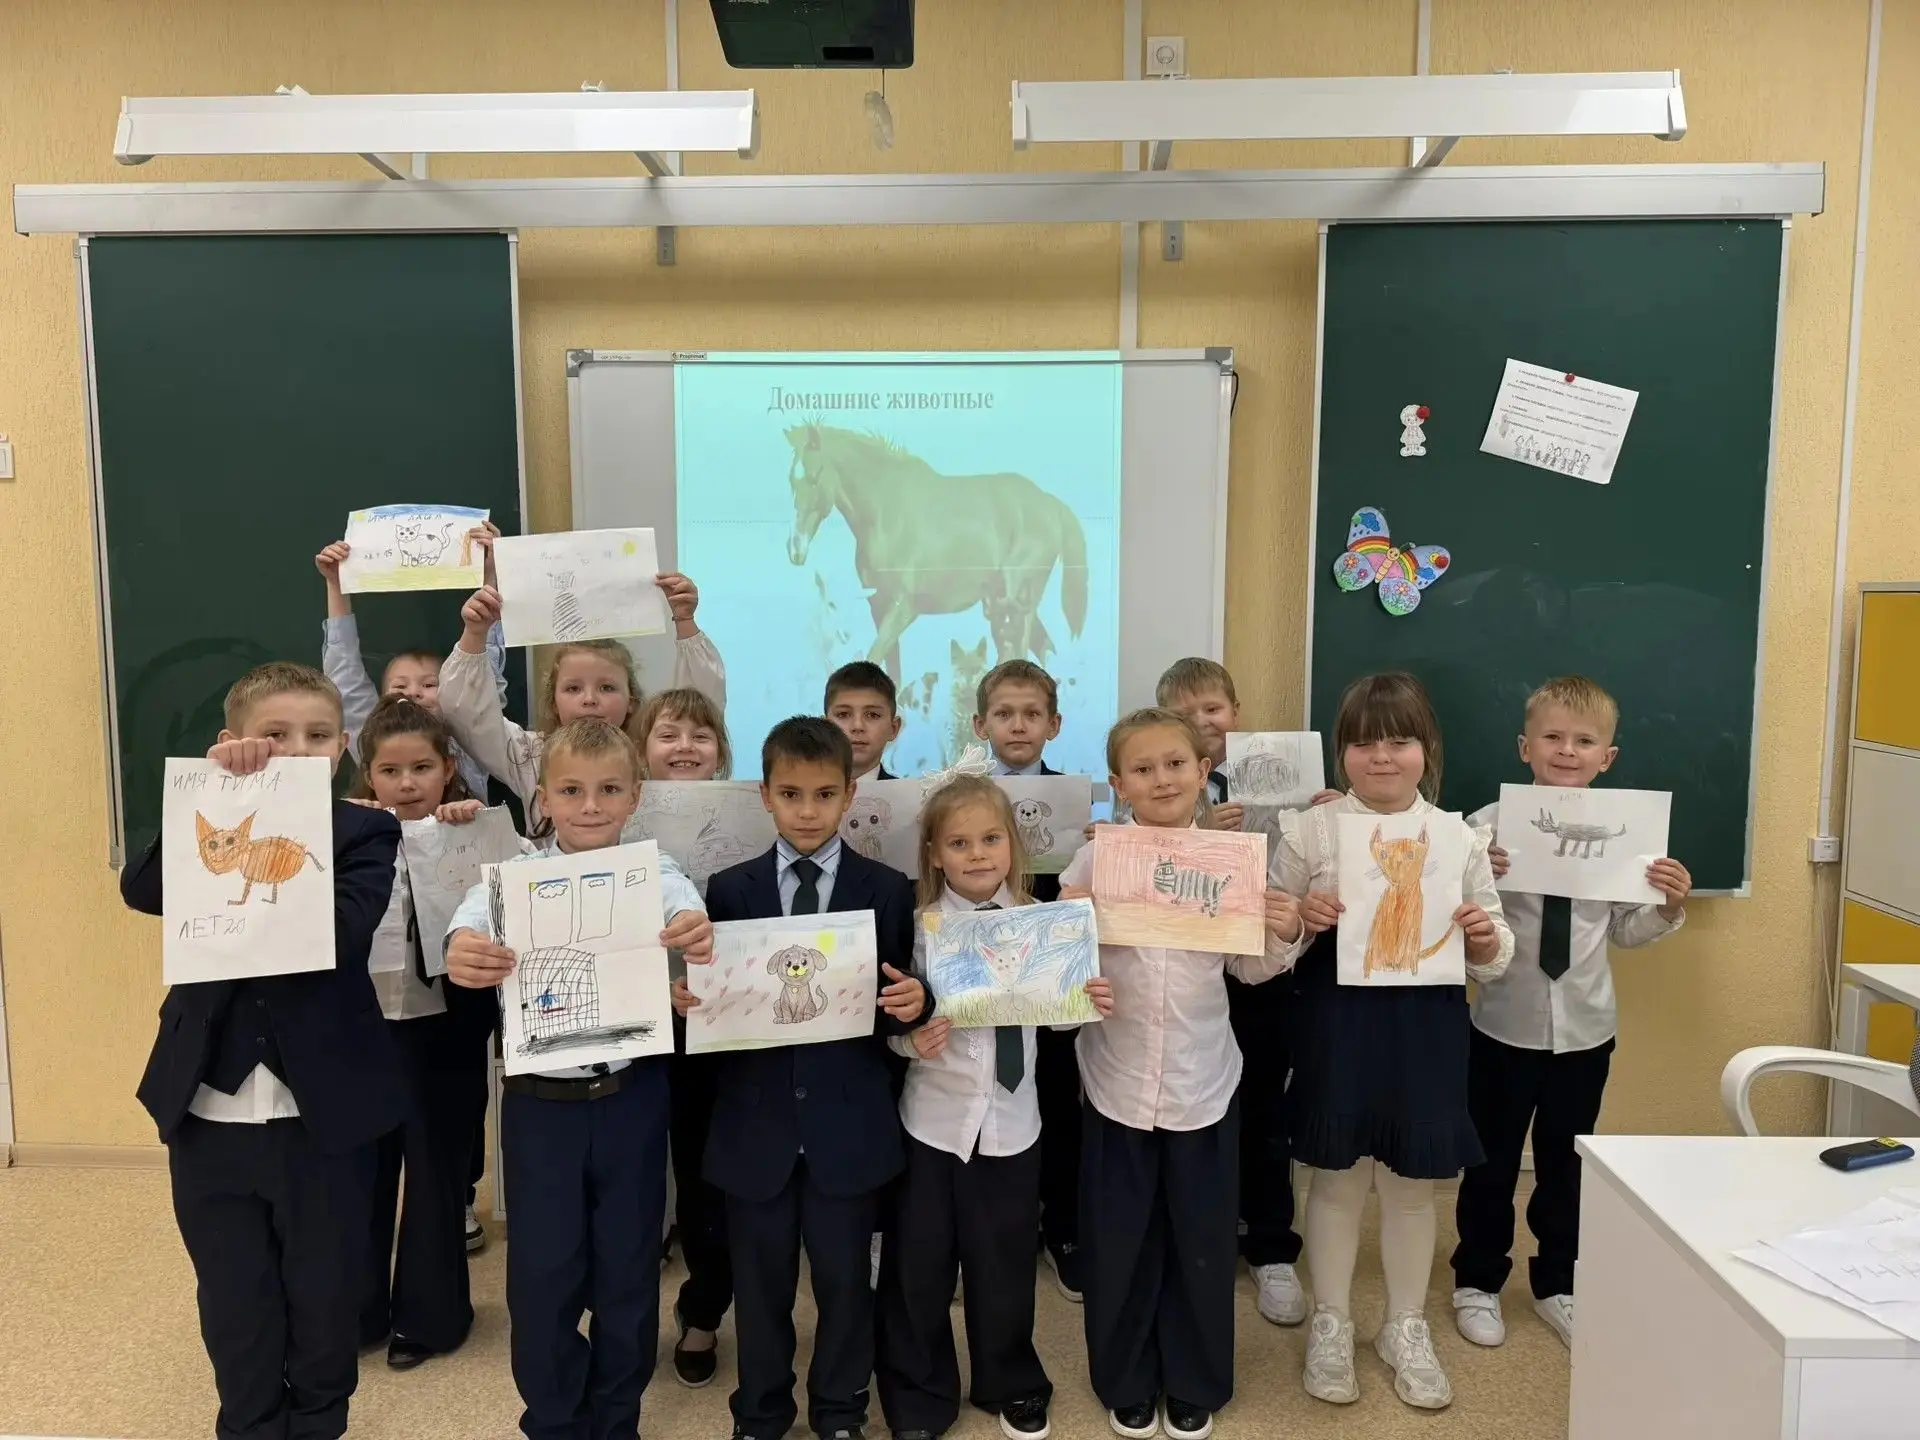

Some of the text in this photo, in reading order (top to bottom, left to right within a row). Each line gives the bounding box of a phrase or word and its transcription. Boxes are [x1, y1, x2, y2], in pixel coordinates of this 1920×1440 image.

[767, 386, 994, 414] Домашние животные
[173, 771, 282, 792] ИМЯ ТИМА
